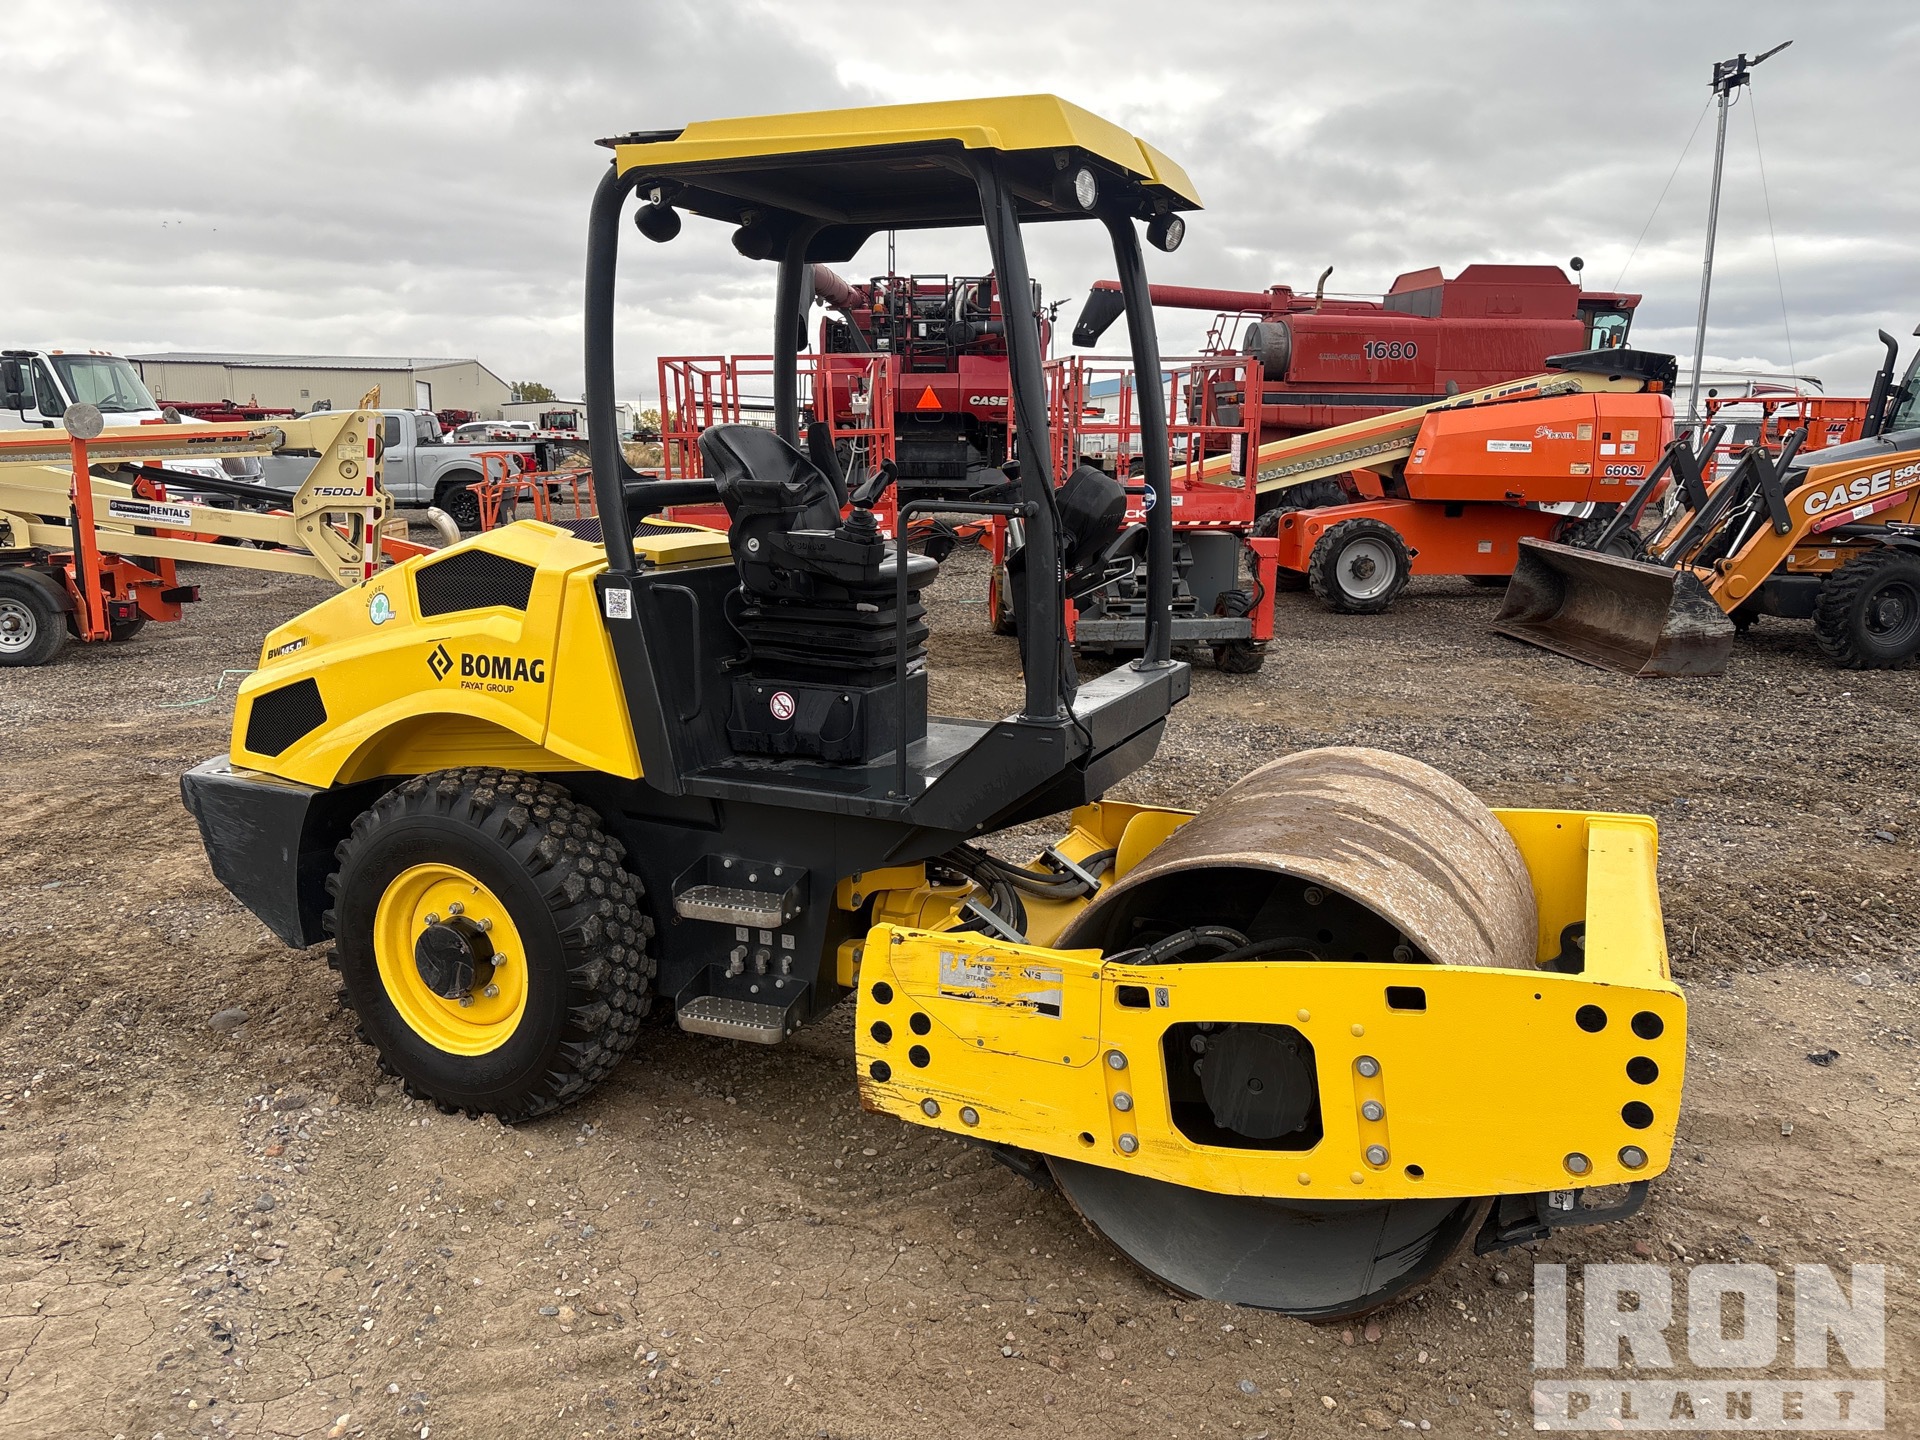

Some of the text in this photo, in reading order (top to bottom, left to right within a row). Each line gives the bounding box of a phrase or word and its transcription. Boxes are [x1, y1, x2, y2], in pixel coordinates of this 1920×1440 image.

[1363, 341, 1418, 360] 1680
[969, 395, 1008, 406] CASE
[1826, 423, 1847, 432] JLG
[1605, 465, 1645, 477] 660SJ
[313, 487, 364, 496] T500J
[1803, 468, 1892, 515] CASE
[150, 505, 190, 518] RENTALS
[365, 585, 385, 608] ECOLOGY
[461, 653, 545, 683] BOMAG
[461, 681, 515, 693] FAYAT GROUP
